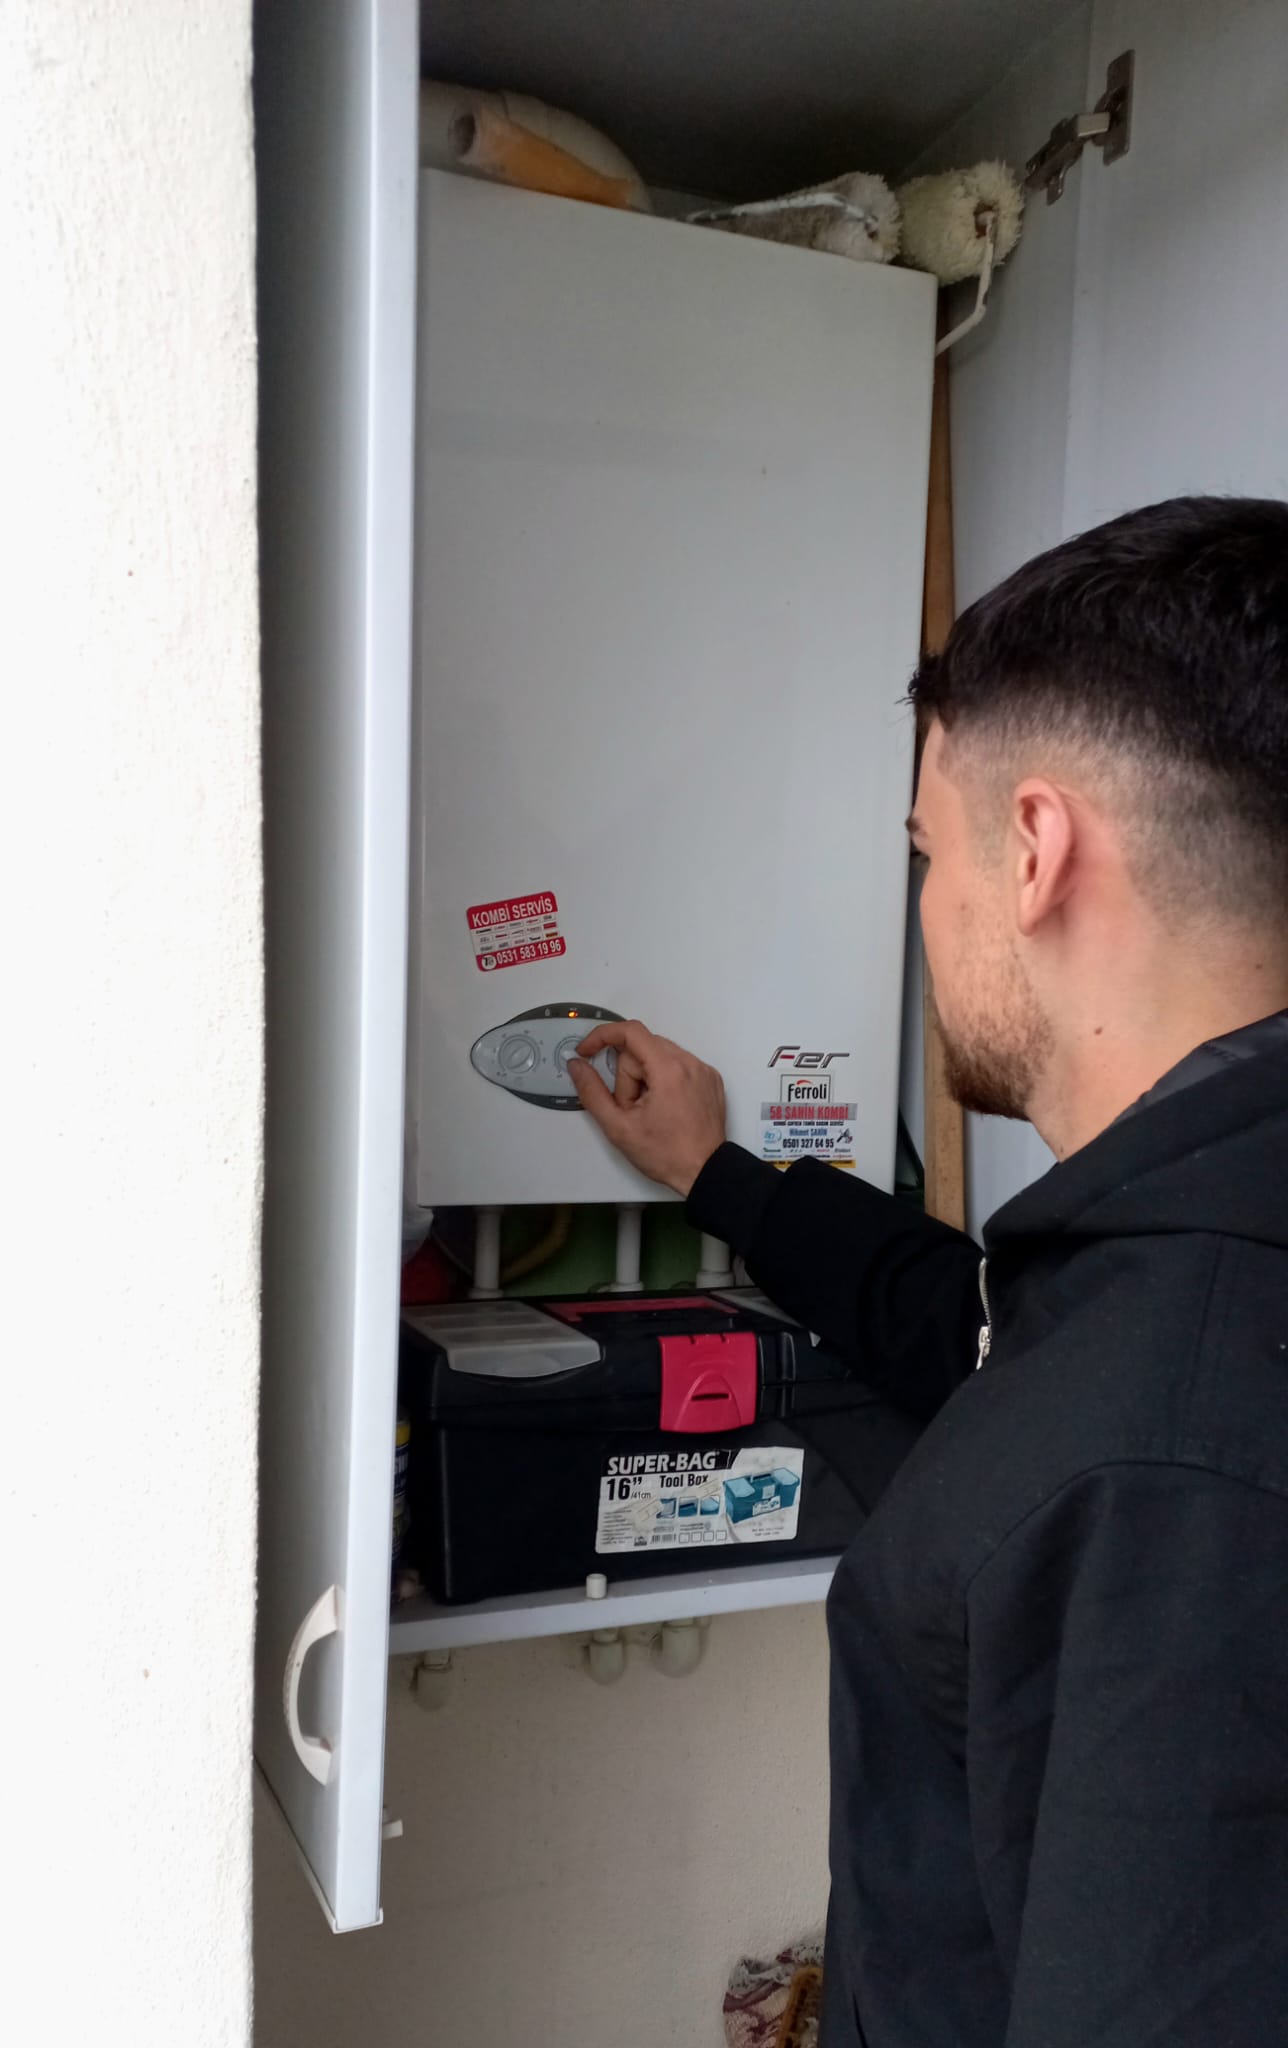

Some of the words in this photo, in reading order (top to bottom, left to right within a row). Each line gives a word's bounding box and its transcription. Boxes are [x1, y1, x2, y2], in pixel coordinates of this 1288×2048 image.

[472, 903, 510, 927] KOMBİ
[512, 896, 553, 919] SERVİS
[496, 949, 518, 965] 0531
[520, 944, 536, 959] 583
[538, 942, 549, 955] 19
[550, 939, 562, 952] 96
[767, 1045, 850, 1068] Fer
[607, 1451, 716, 1476] SUPER-BAG
[659, 1475, 684, 1488] Tool
[688, 1473, 709, 1487] Box
